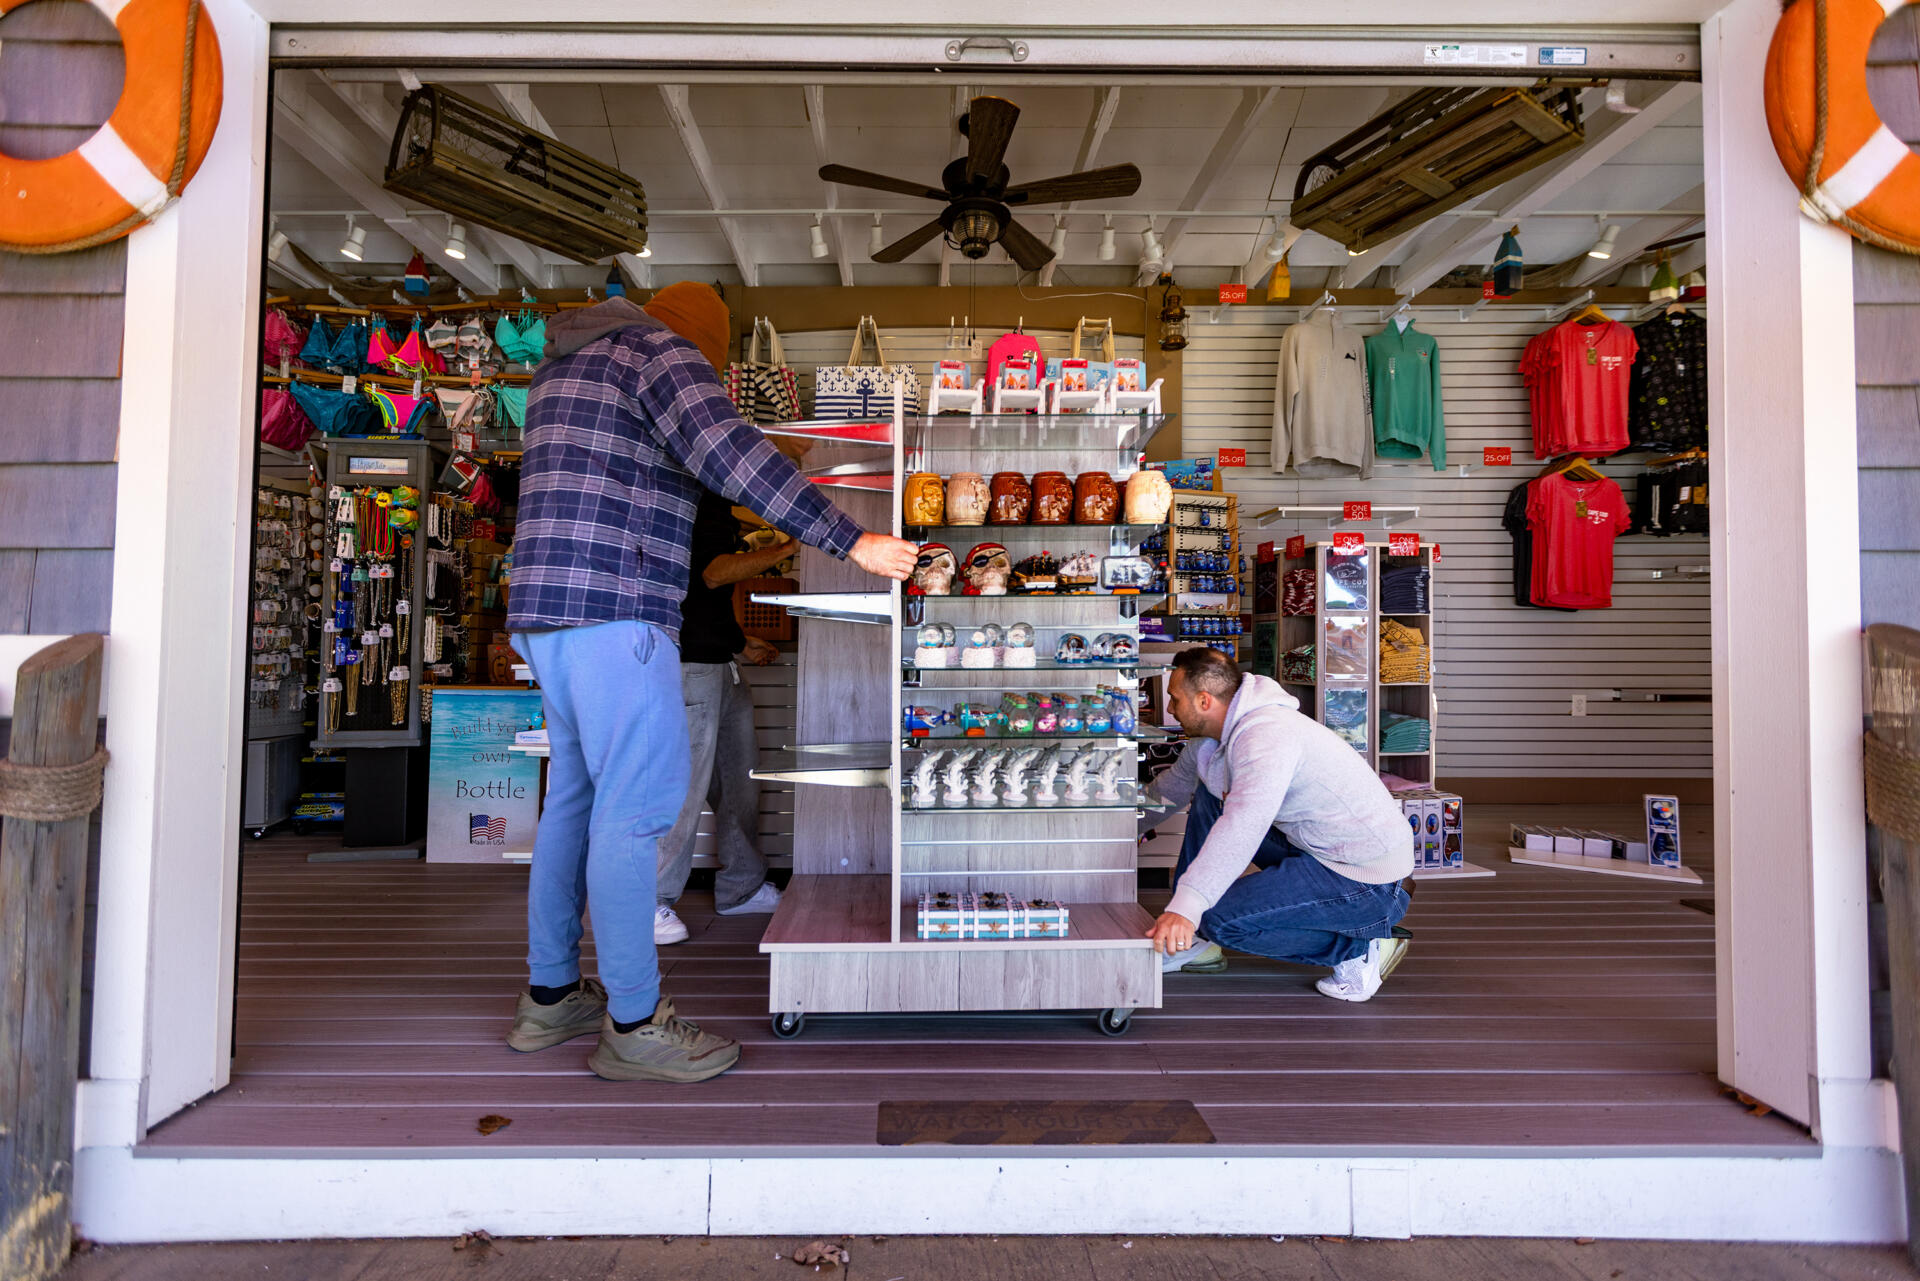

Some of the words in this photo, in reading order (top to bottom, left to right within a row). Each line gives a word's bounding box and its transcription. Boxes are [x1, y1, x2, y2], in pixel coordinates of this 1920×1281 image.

[1352, 504, 1368, 512] ONE
[1342, 536, 1359, 544] ONE
[1398, 536, 1415, 544] ONE
[452, 716, 491, 740] Build
[472, 752, 511, 764] own
[456, 777, 525, 799] Bottle
[891, 1111, 1002, 1130] WATCH
[1014, 1111, 1106, 1130] YOUR
[1116, 1111, 1192, 1130] STEP
